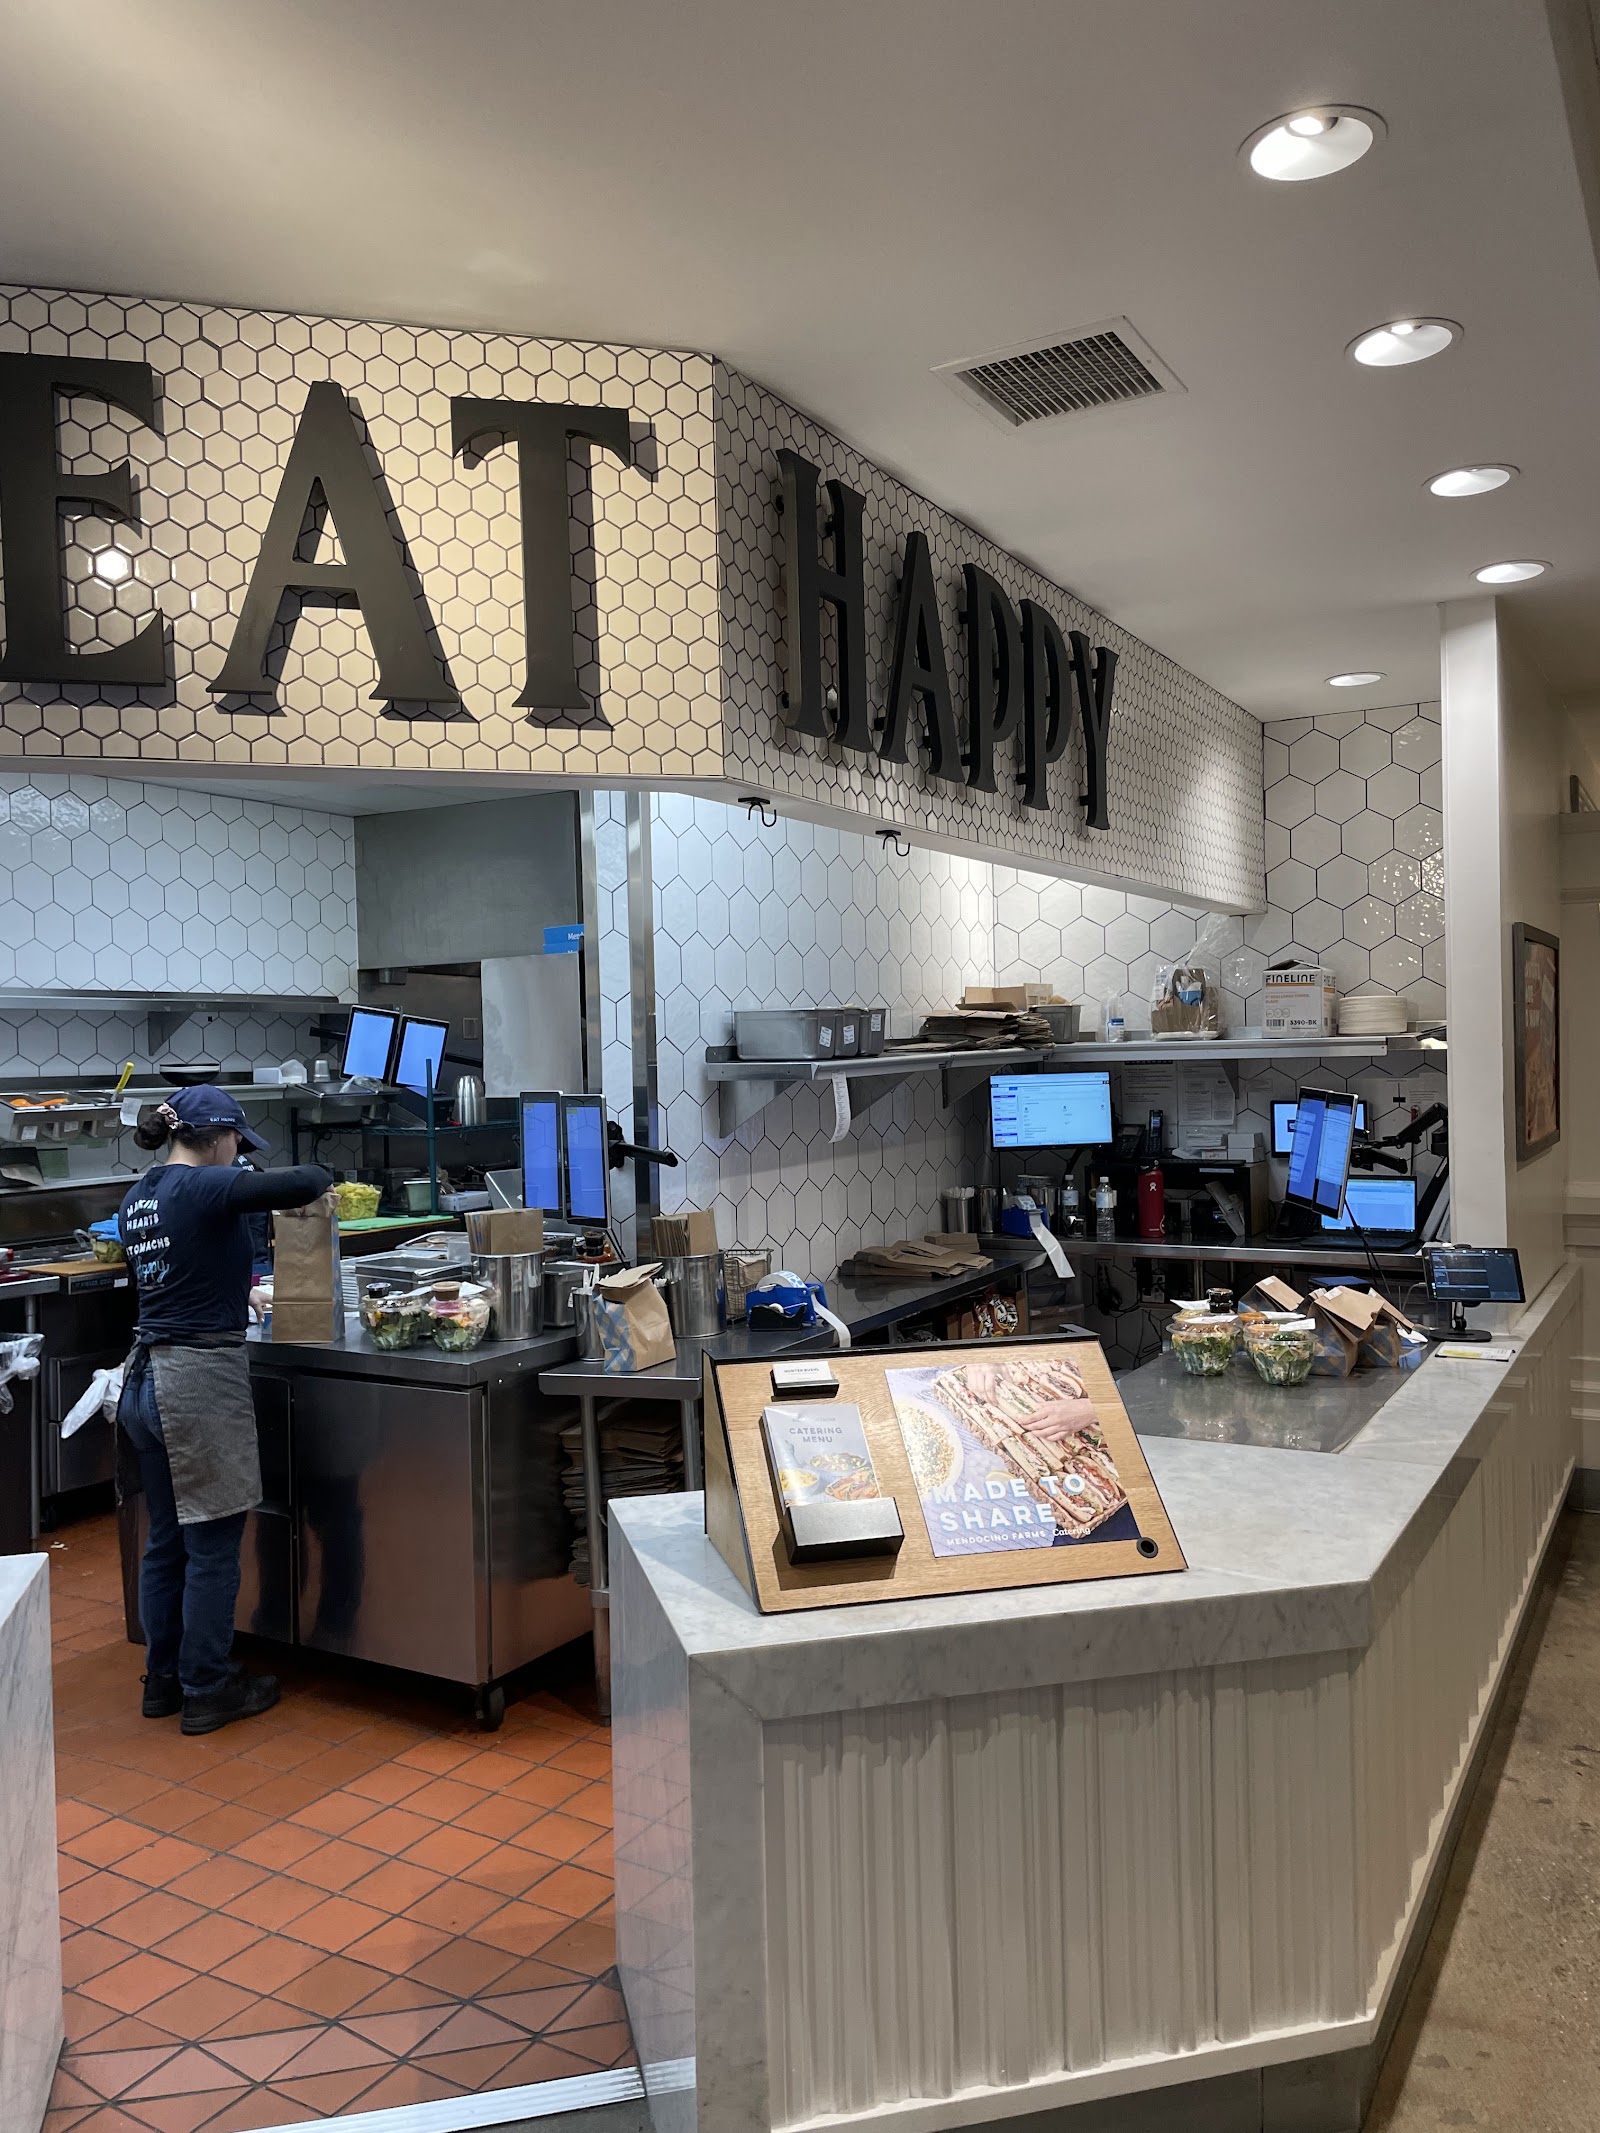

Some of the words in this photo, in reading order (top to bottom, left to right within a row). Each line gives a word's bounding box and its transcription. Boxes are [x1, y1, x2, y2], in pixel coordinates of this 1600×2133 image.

[0, 353, 634, 710] EAT
[776, 448, 1120, 830] HAPPY
[1265, 974, 1315, 983] FINELINE
[126, 1213, 159, 1231] HEARTS
[789, 1427, 842, 1435] CATERING
[931, 1478, 1029, 1504] MADE
[1040, 1473, 1086, 1496] TO
[939, 1503, 1056, 1532] SHARE
[946, 1534, 1009, 1546] MENDOCINO
[1012, 1530, 1046, 1540] FARMS
[1052, 1527, 1091, 1537] Catering
